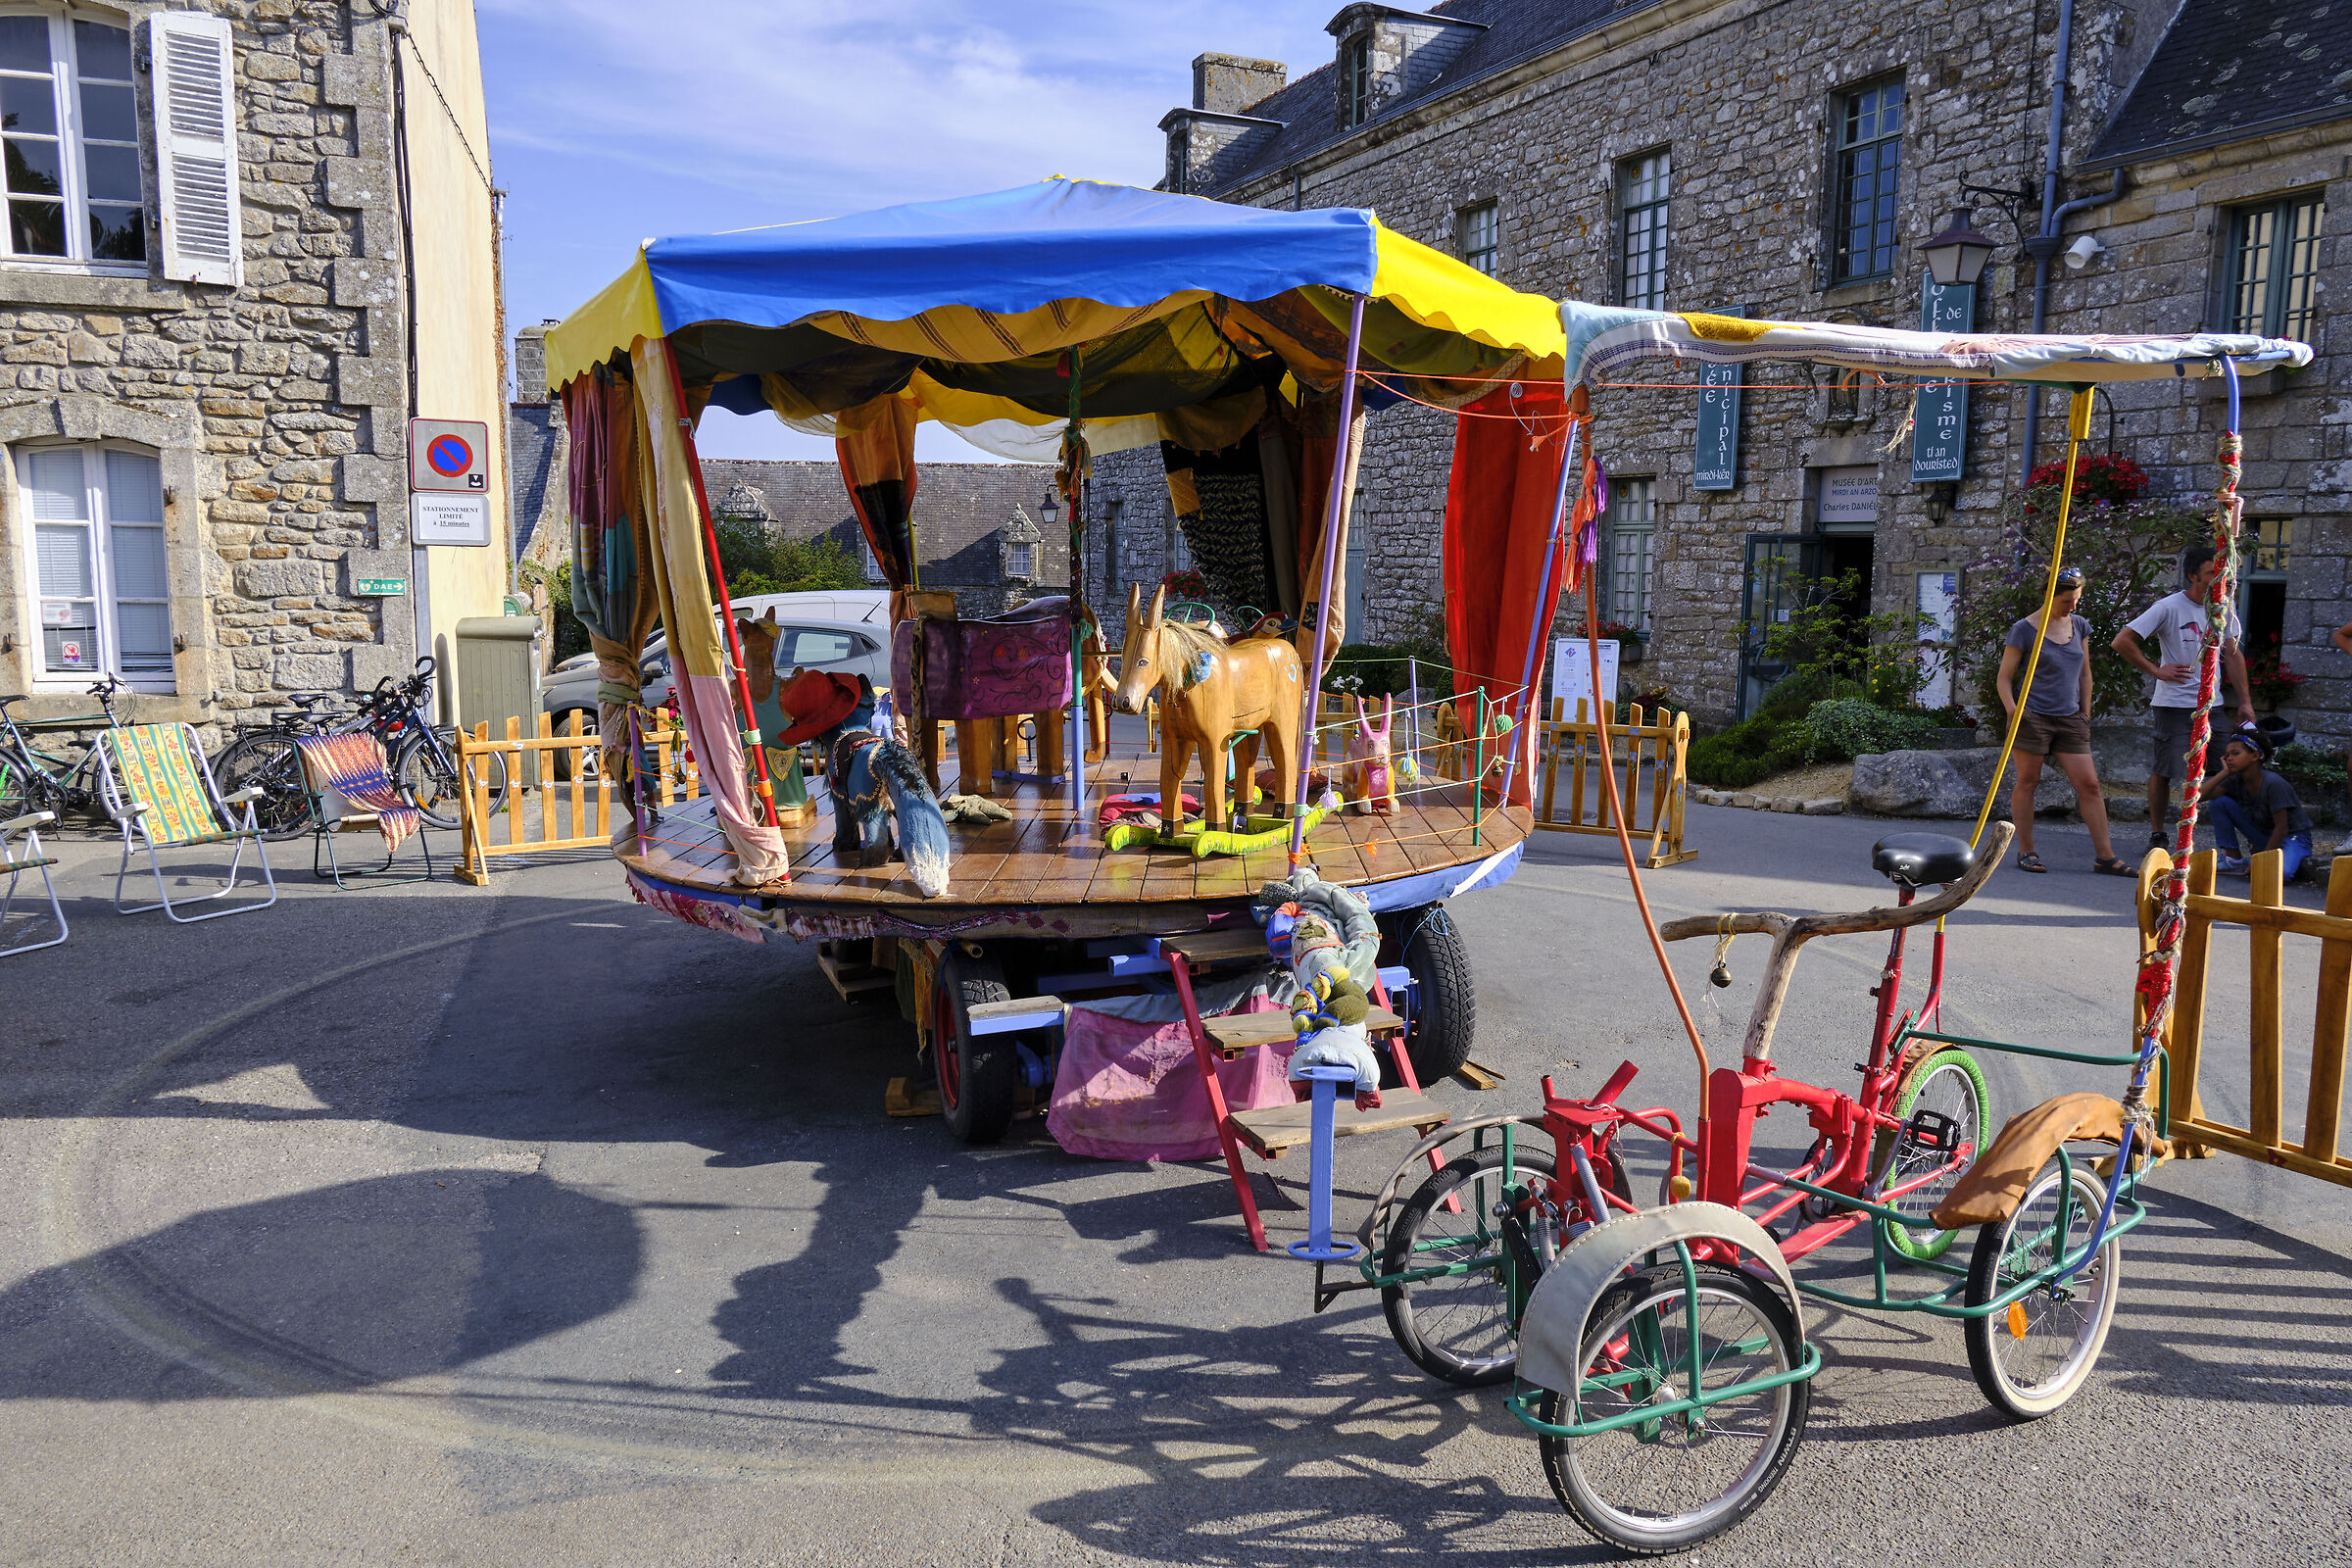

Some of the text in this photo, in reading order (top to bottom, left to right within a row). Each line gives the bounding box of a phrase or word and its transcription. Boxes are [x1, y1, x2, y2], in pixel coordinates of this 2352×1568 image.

[1946, 307, 1962, 320] de
[1718, 364, 1733, 466] nicipal
[1935, 447, 1946, 458] an
[1823, 501, 1879, 512] Charles DANIÉL
